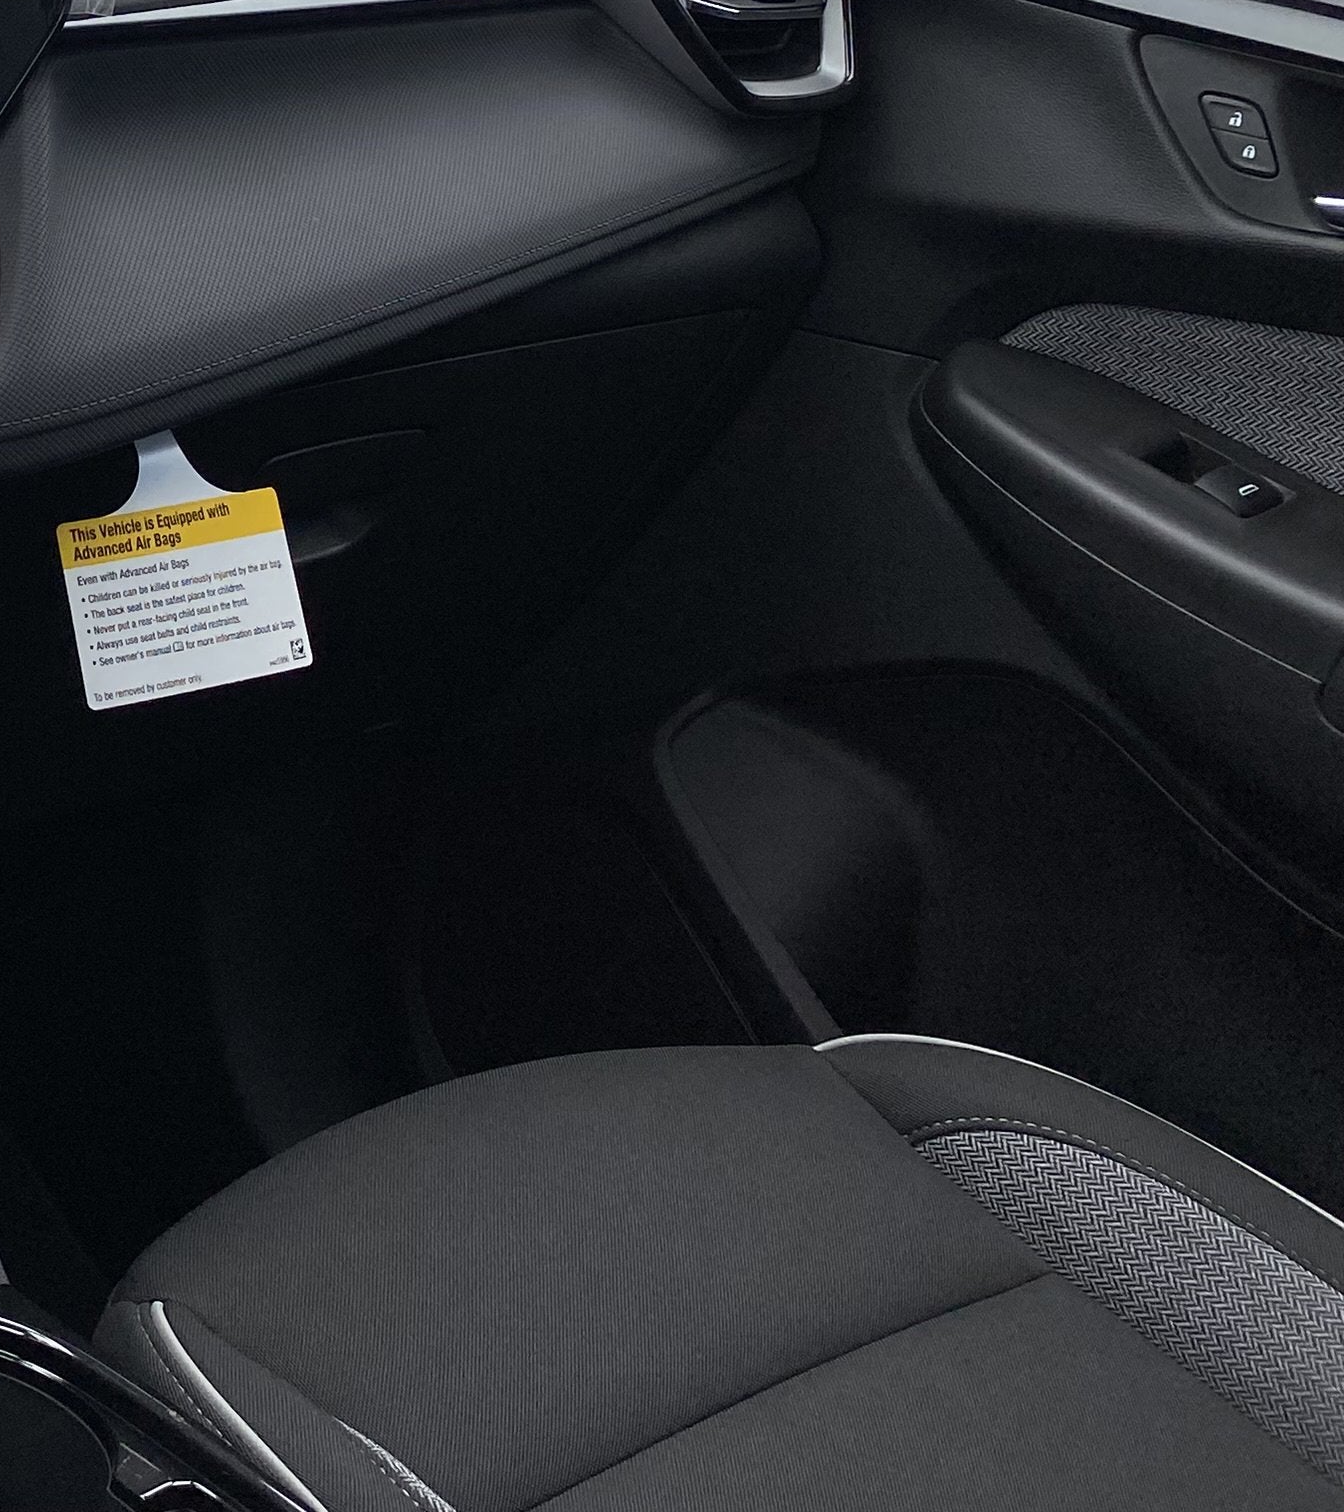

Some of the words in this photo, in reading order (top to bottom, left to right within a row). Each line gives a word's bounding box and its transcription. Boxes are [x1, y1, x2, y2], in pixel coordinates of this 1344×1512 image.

[69, 527, 97, 543] This
[99, 519, 142, 539] Vehicle
[144, 517, 155, 531] is
[157, 507, 205, 529] Equipped
[206, 502, 230, 519] with
[74, 539, 133, 562] Advanced
[136, 536, 151, 551] Air
[154, 531, 182, 548] Bags
[77, 576, 98, 586] Even
[99, 572, 118, 582] with
[120, 564, 158, 579] Advanced
[159, 562, 169, 571] Air
[170, 558, 190, 570] Bags
[88, 591, 121, 603] Children
[123, 588, 137, 598] can
[139, 586, 148, 594] be
[150, 581, 170, 592] killed
[172, 580, 179, 588] or
[181, 574, 212, 587] seriously
[213, 568, 237, 581] injured
[248, 565, 259, 573] the
[91, 609, 106, 619] The
[106, 606, 125, 616] back
[126, 603, 143, 613] seat
[152, 599, 163, 608] the
[165, 594, 186, 606] safest
[187, 591, 206, 603] place
[206, 588, 216, 597] for
[93, 623, 116, 635] Never
[117, 621, 130, 632] put
[138, 612, 177, 627] rear-facing
[178, 608, 196, 619] child
[197, 605, 211, 615] seat
[97, 638, 124, 650] Always
[125, 636, 139, 645] use
[140, 633, 156, 643] seat
[176, 625, 189, 635] and
[190, 622, 207, 632] child
[99, 657, 114, 666] See
[146, 644, 172, 657] manual
[185, 640, 195, 649] for
[197, 637, 215, 647] more
[253, 624, 272, 636] about
[94, 692, 103, 702] To
[104, 691, 113, 700] be
[115, 685, 145, 699] removed
[146, 683, 155, 693] by
[156, 677, 186, 691] customer
